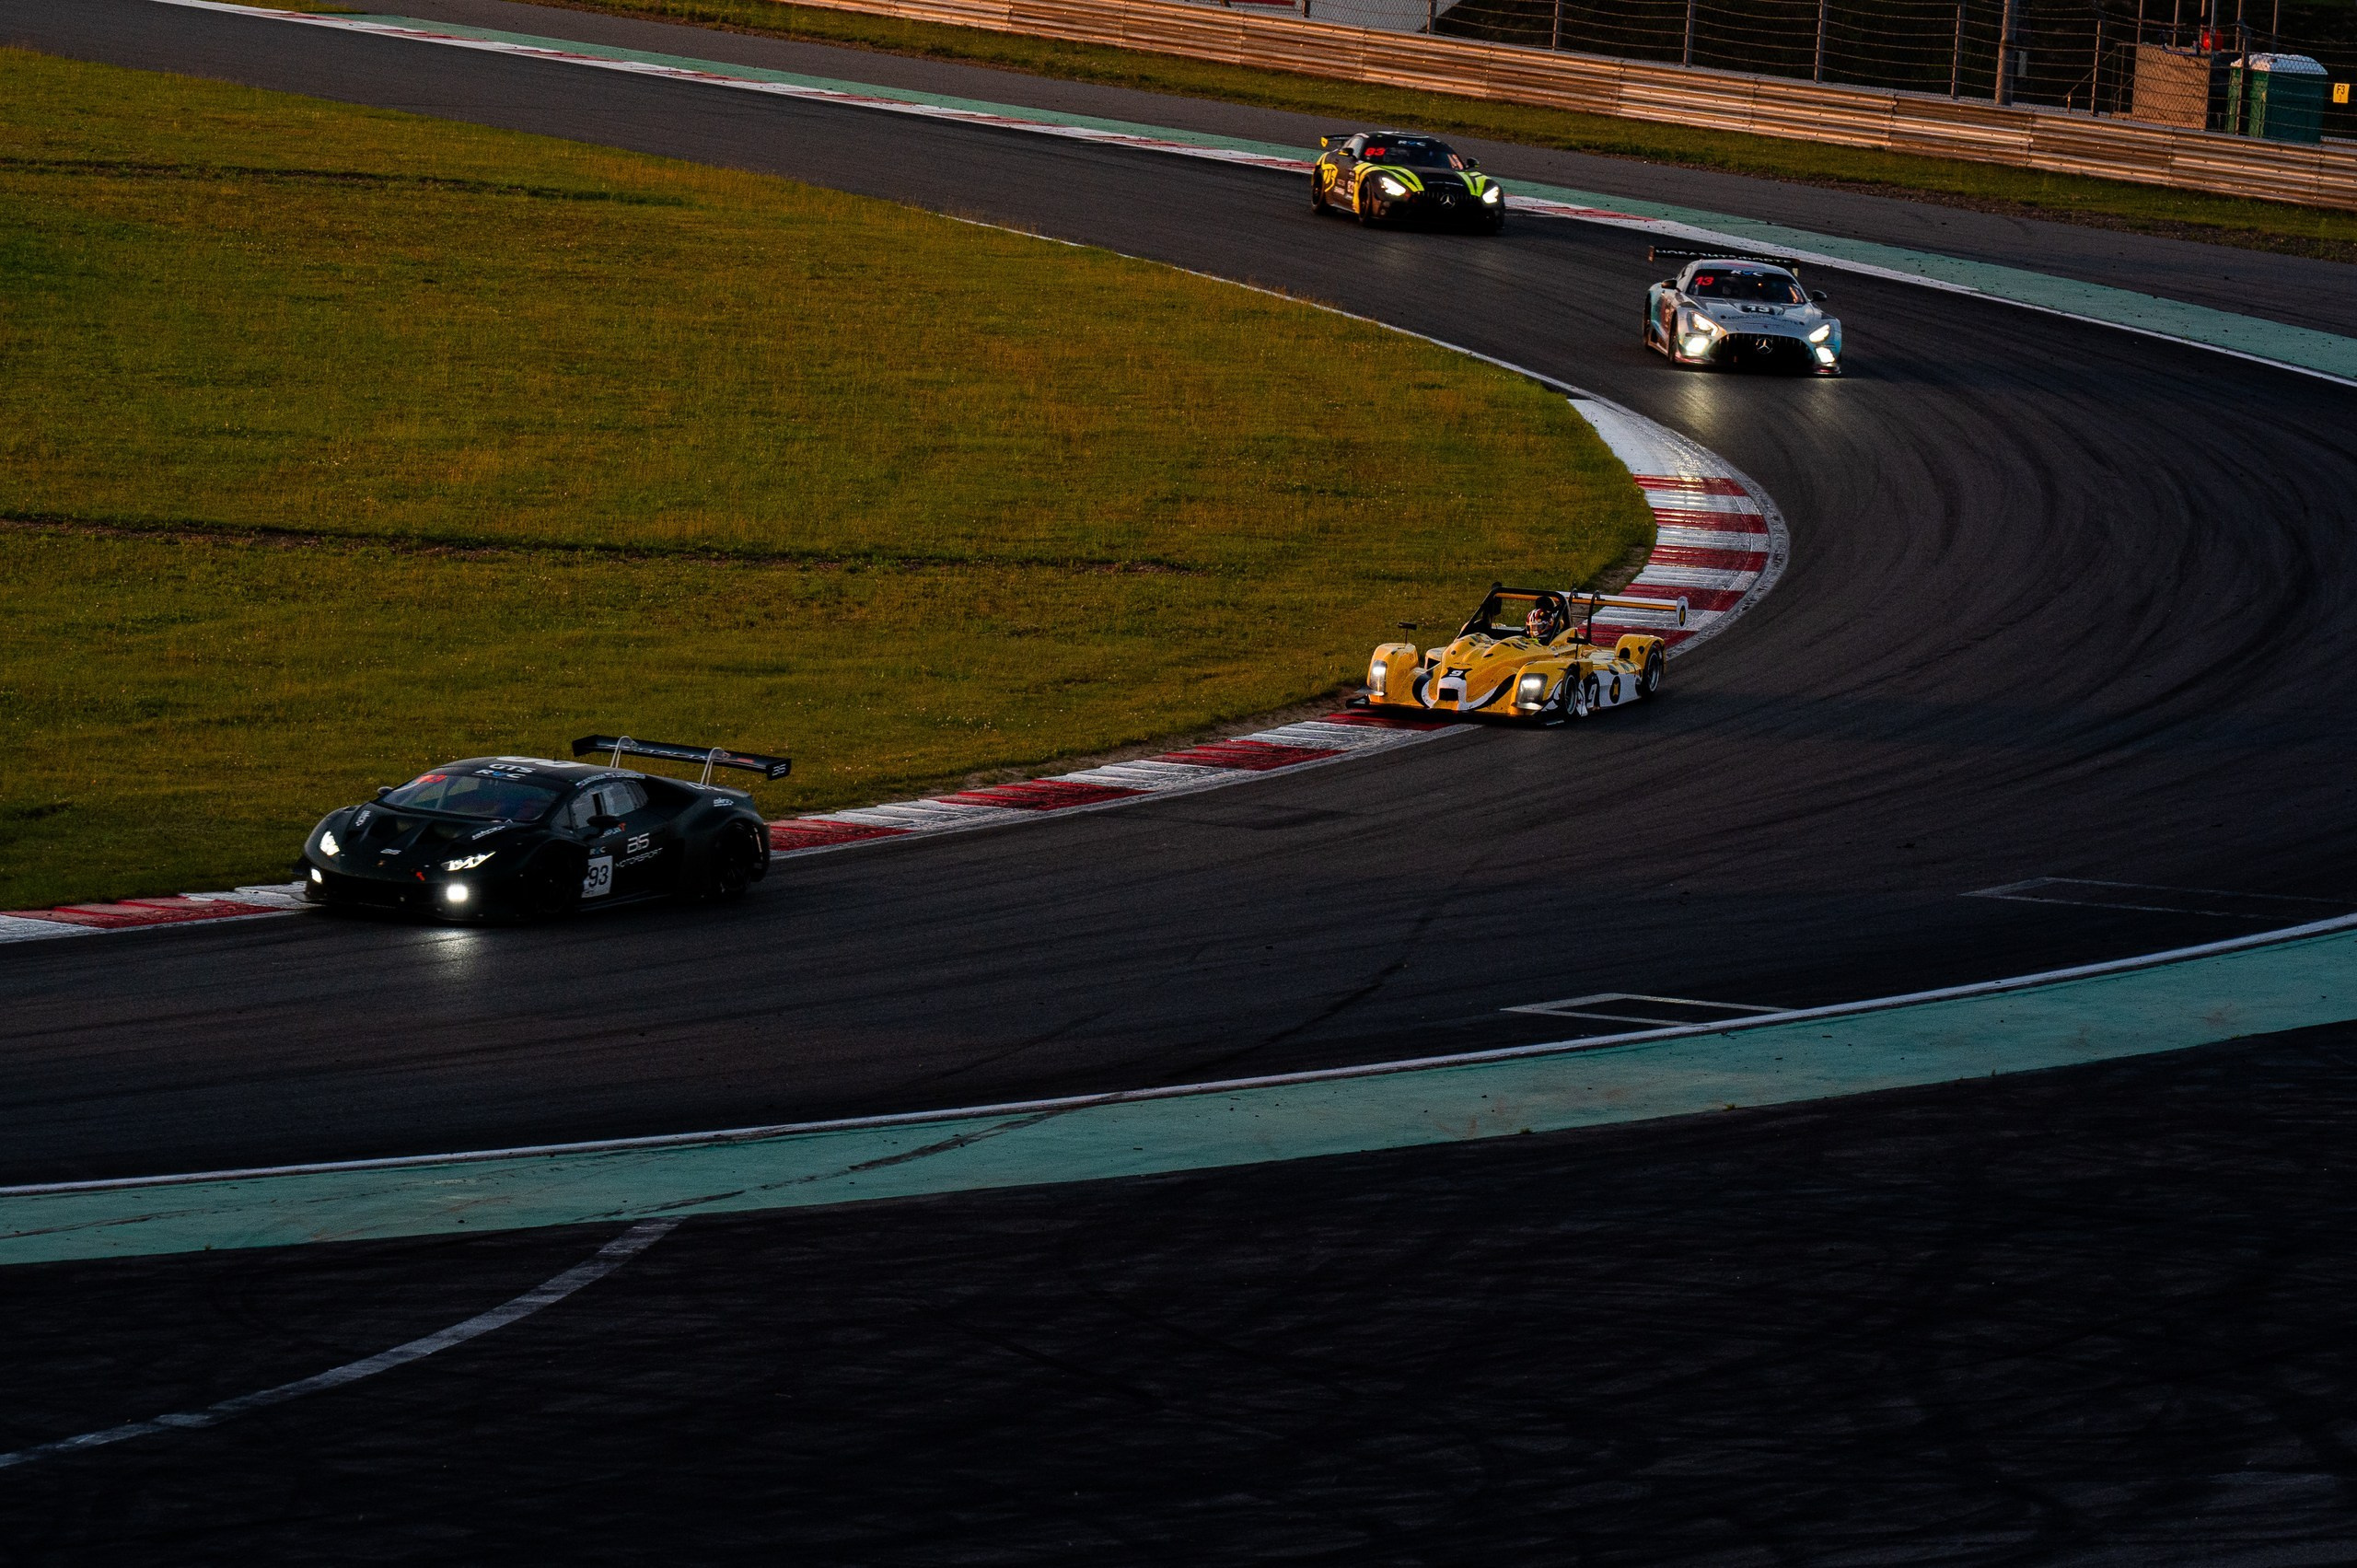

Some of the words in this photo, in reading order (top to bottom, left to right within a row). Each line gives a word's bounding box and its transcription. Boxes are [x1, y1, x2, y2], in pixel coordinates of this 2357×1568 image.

[1364, 147, 1387, 157] 83
[1694, 275, 1715, 286] 13
[1747, 305, 1770, 313] 13
[1587, 683, 1597, 707] 9
[489, 763, 537, 773] GTS
[626, 832, 650, 854] BS
[588, 865, 609, 888] 93
